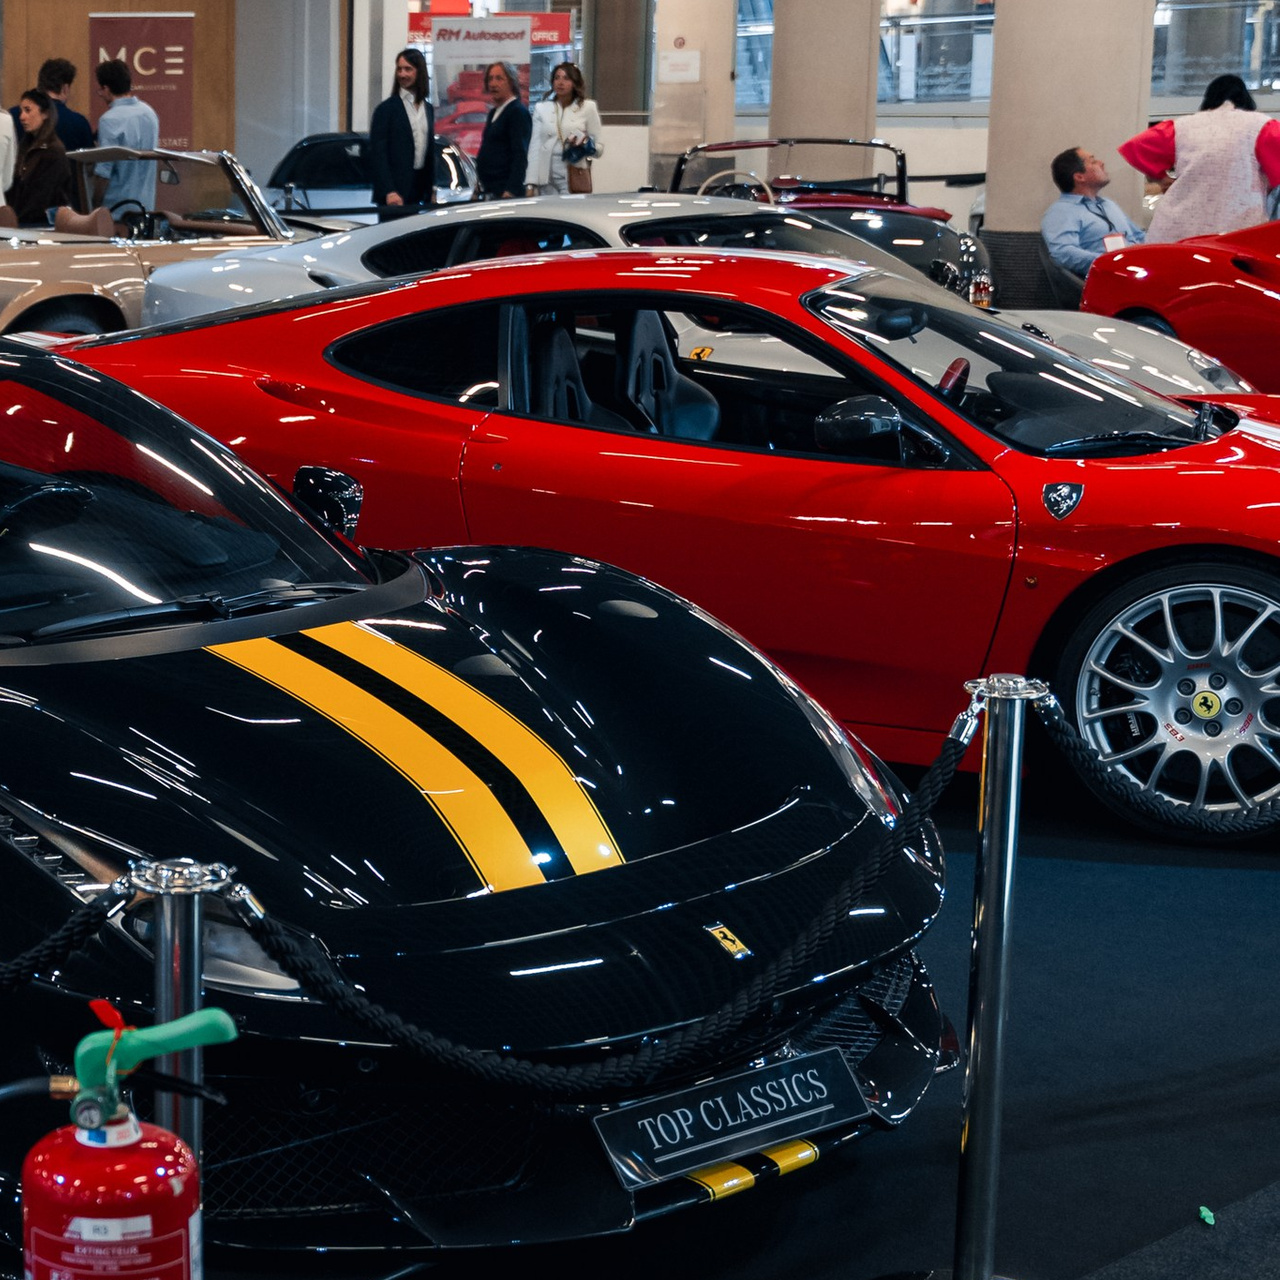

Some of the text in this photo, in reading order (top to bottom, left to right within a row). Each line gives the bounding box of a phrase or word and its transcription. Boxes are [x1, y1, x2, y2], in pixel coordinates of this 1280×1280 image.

[436, 27, 526, 44] RM Autosport
[531, 30, 559, 42] OFFICE
[1126, 712, 1141, 737] rrari
[638, 1068, 828, 1150] TOP CLASSICS
